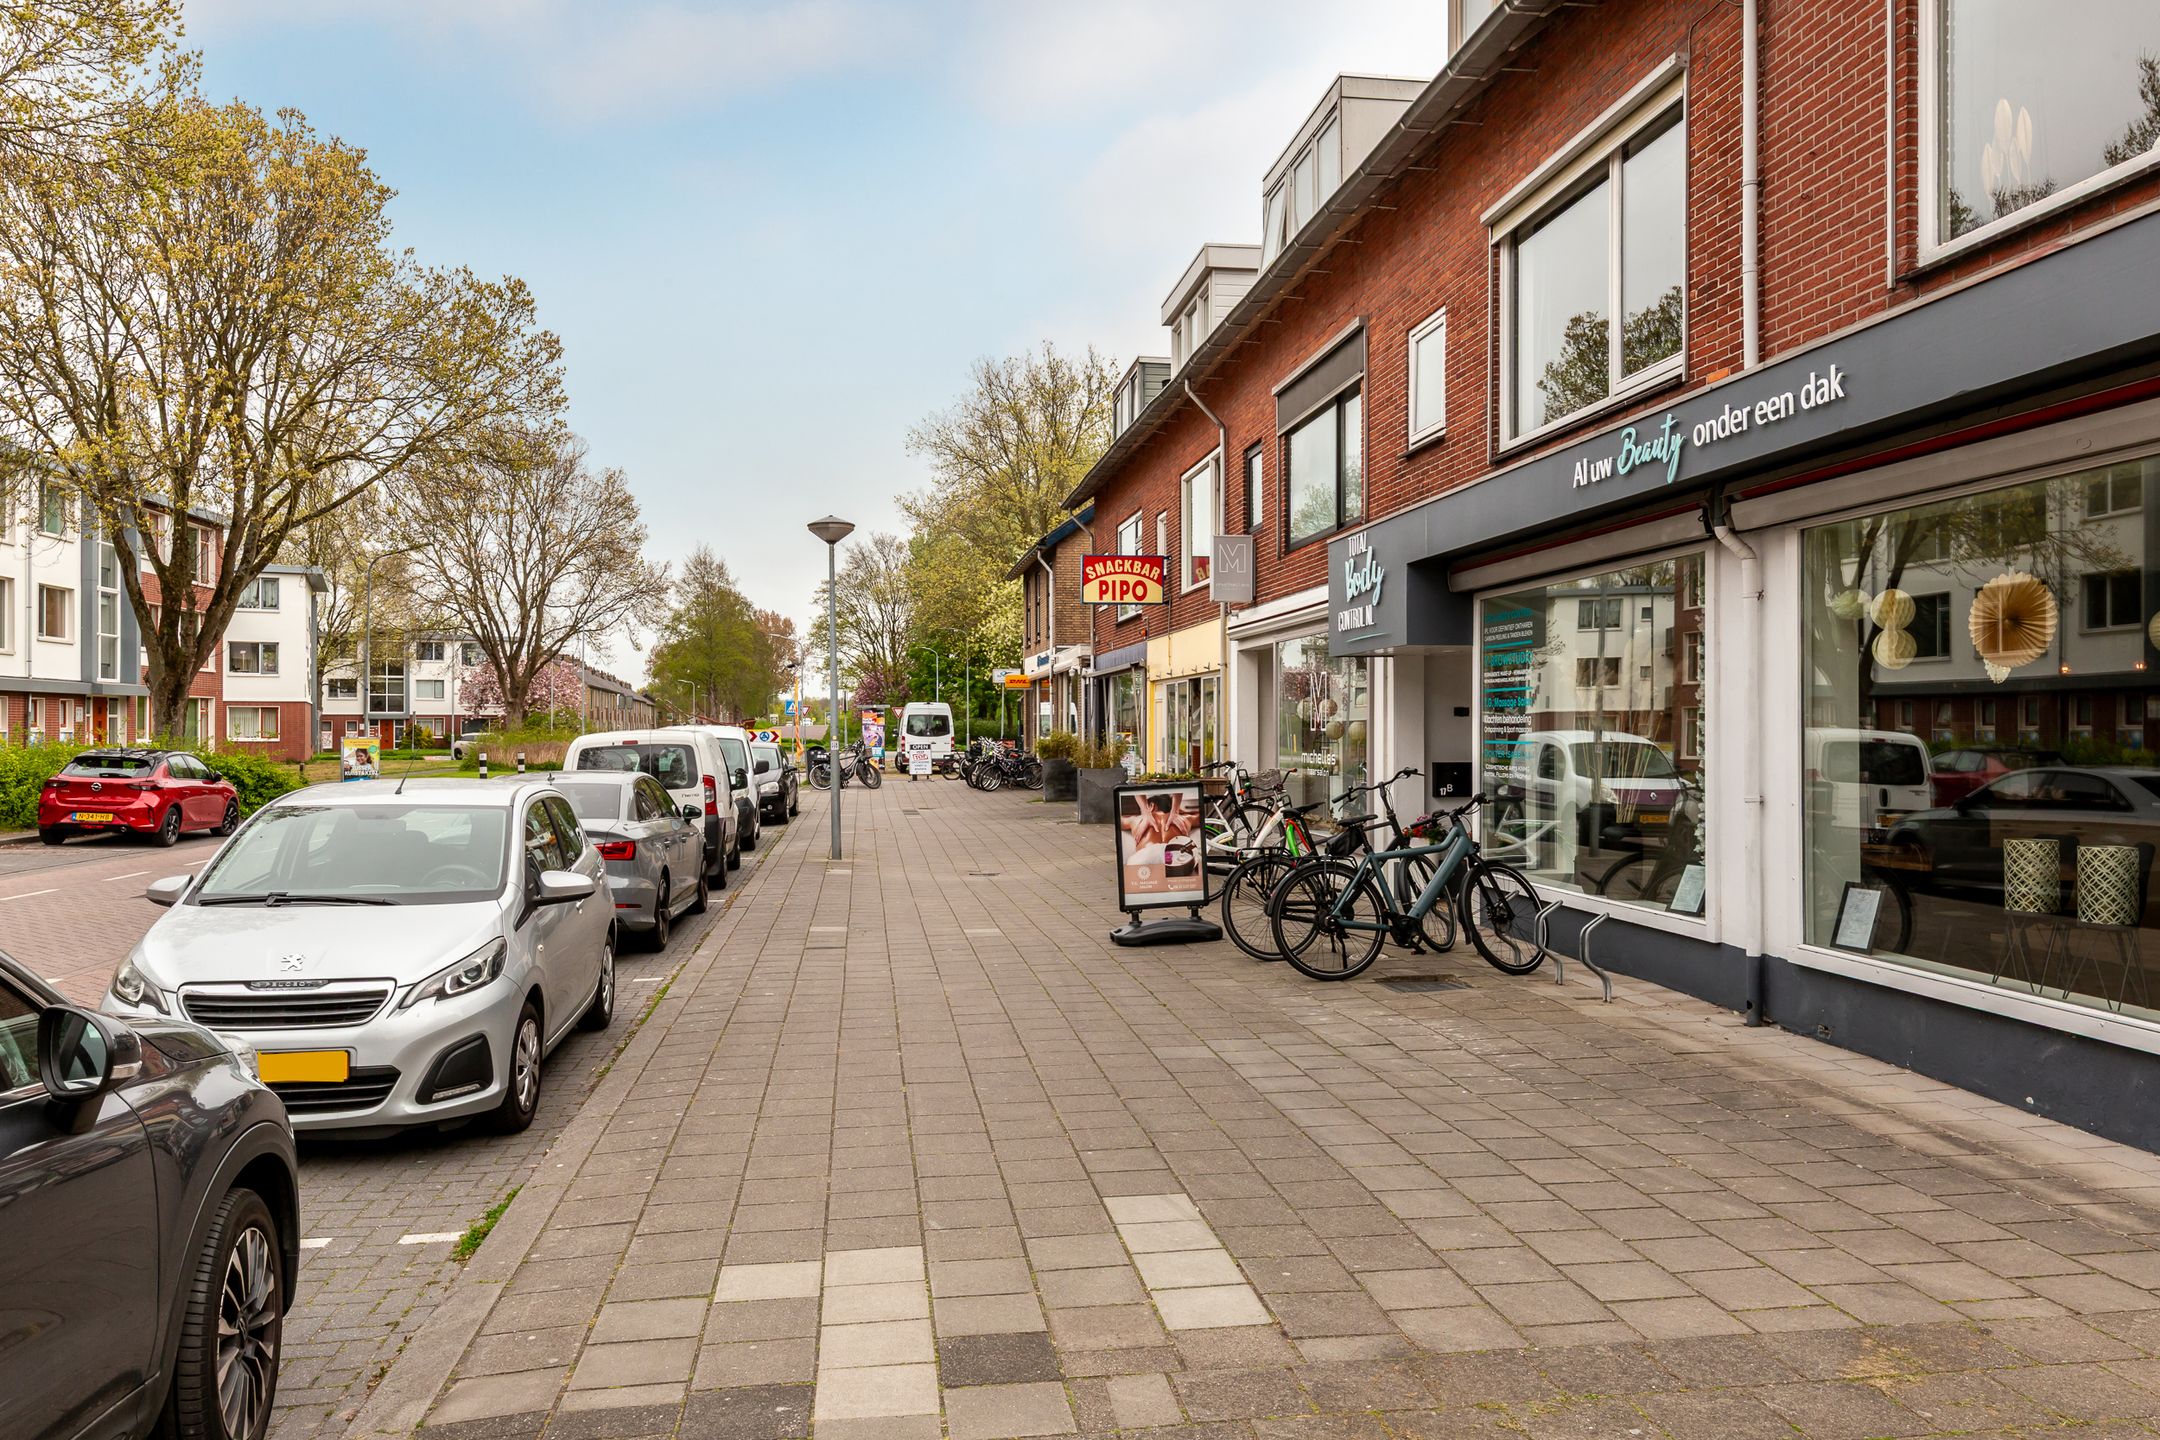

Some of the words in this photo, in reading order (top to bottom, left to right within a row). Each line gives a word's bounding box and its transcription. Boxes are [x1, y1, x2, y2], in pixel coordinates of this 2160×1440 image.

[1573, 458, 1588, 488] Al
[1590, 457, 1613, 484] uw
[1617, 413, 1686, 483] Beauty
[1693, 405, 1752, 447] onder
[1755, 391, 1794, 425] een
[1800, 364, 1845, 410] dak
[1348, 531, 1368, 557] TOTAL
[1085, 559, 1161, 581] SNACKBAR
[1219, 544, 1246, 573] M
[1345, 546, 1384, 606] Body
[1099, 580, 1148, 601] PIPO
[1338, 607, 1365, 632] CONTROL
